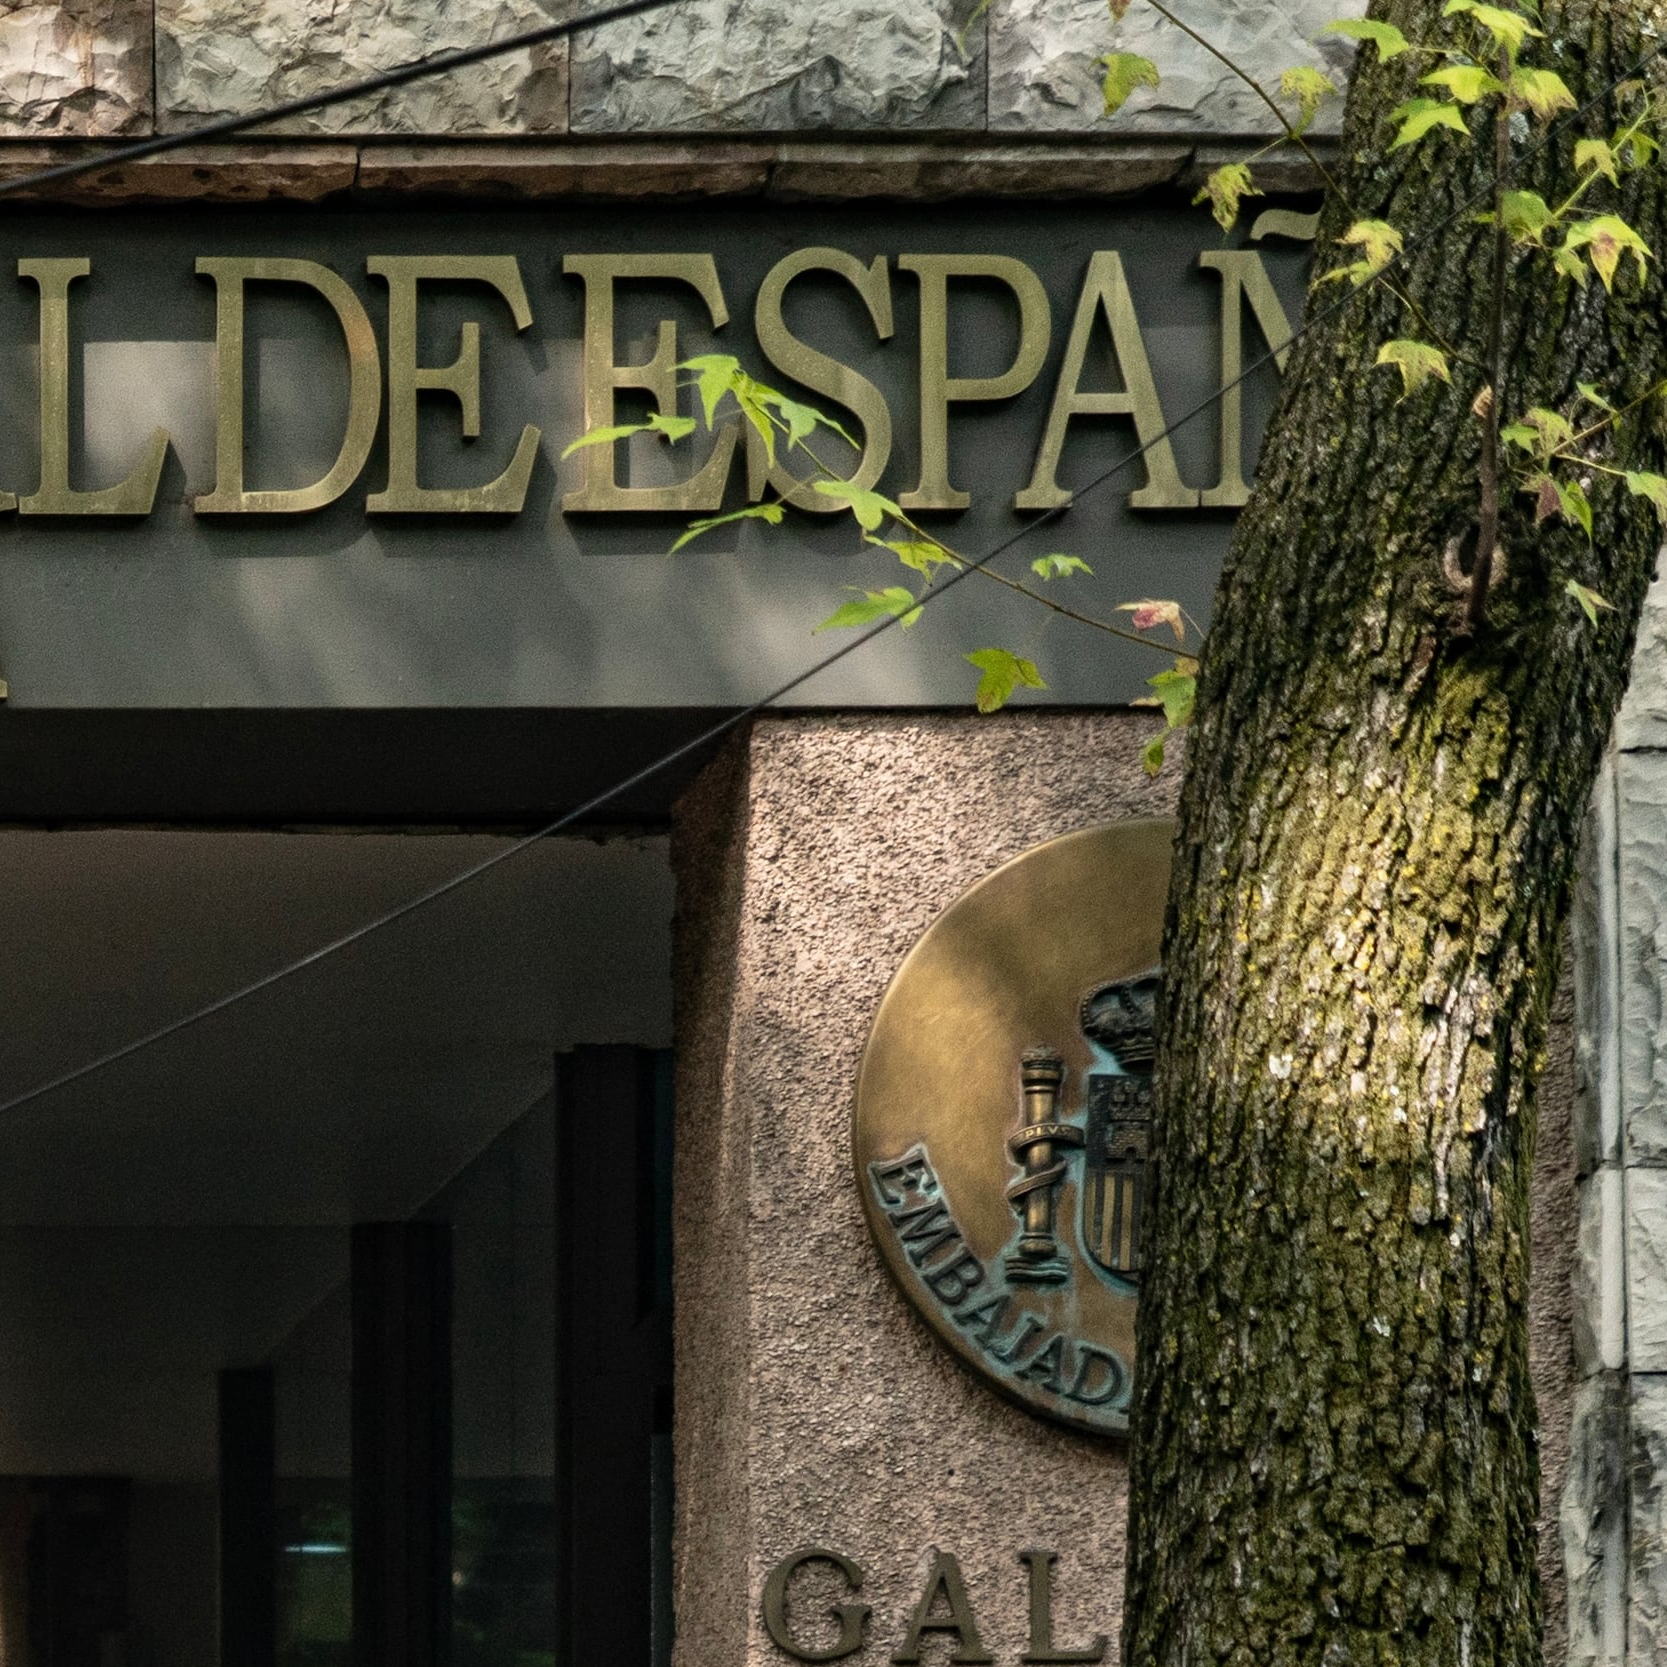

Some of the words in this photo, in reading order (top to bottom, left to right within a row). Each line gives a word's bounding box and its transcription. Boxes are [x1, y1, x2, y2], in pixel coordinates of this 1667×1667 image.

[193, 254, 543, 516] DE
[868, 1142, 1130, 1414] EMBAJAD
[762, 1548, 1110, 1665] GAL
